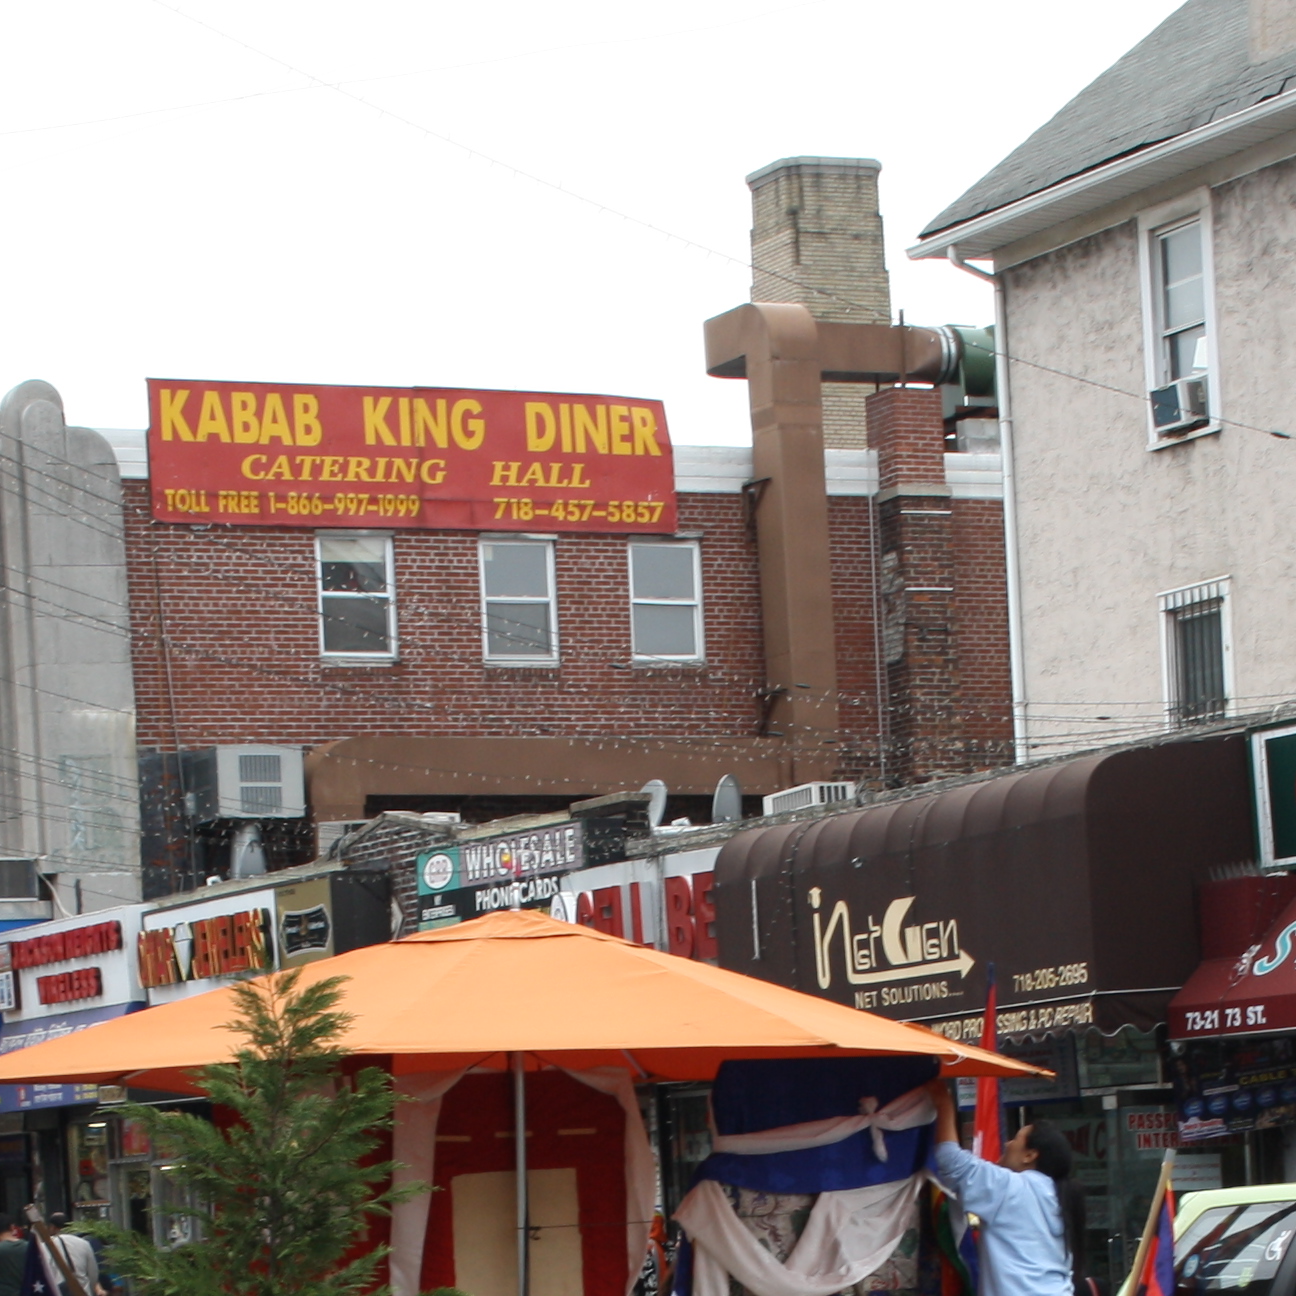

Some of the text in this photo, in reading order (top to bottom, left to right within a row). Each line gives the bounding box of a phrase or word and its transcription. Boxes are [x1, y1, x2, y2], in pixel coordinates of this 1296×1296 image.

[159, 388, 662, 457] KABAB KING DINER
[241, 453, 591, 488] CATERING HALL
[164, 489, 665, 525] TOLL FREE 1-866-997-1999 718-457-5857
[465, 827, 576, 881] WHOLESALE
[519, 876, 559, 903] CARDS
[855, 991, 878, 1009] NET
[1054, 1002, 1094, 1027] REPAIR
[1185, 1009, 1220, 1031] 73-21
[1224, 1007, 1242, 1028] 73
